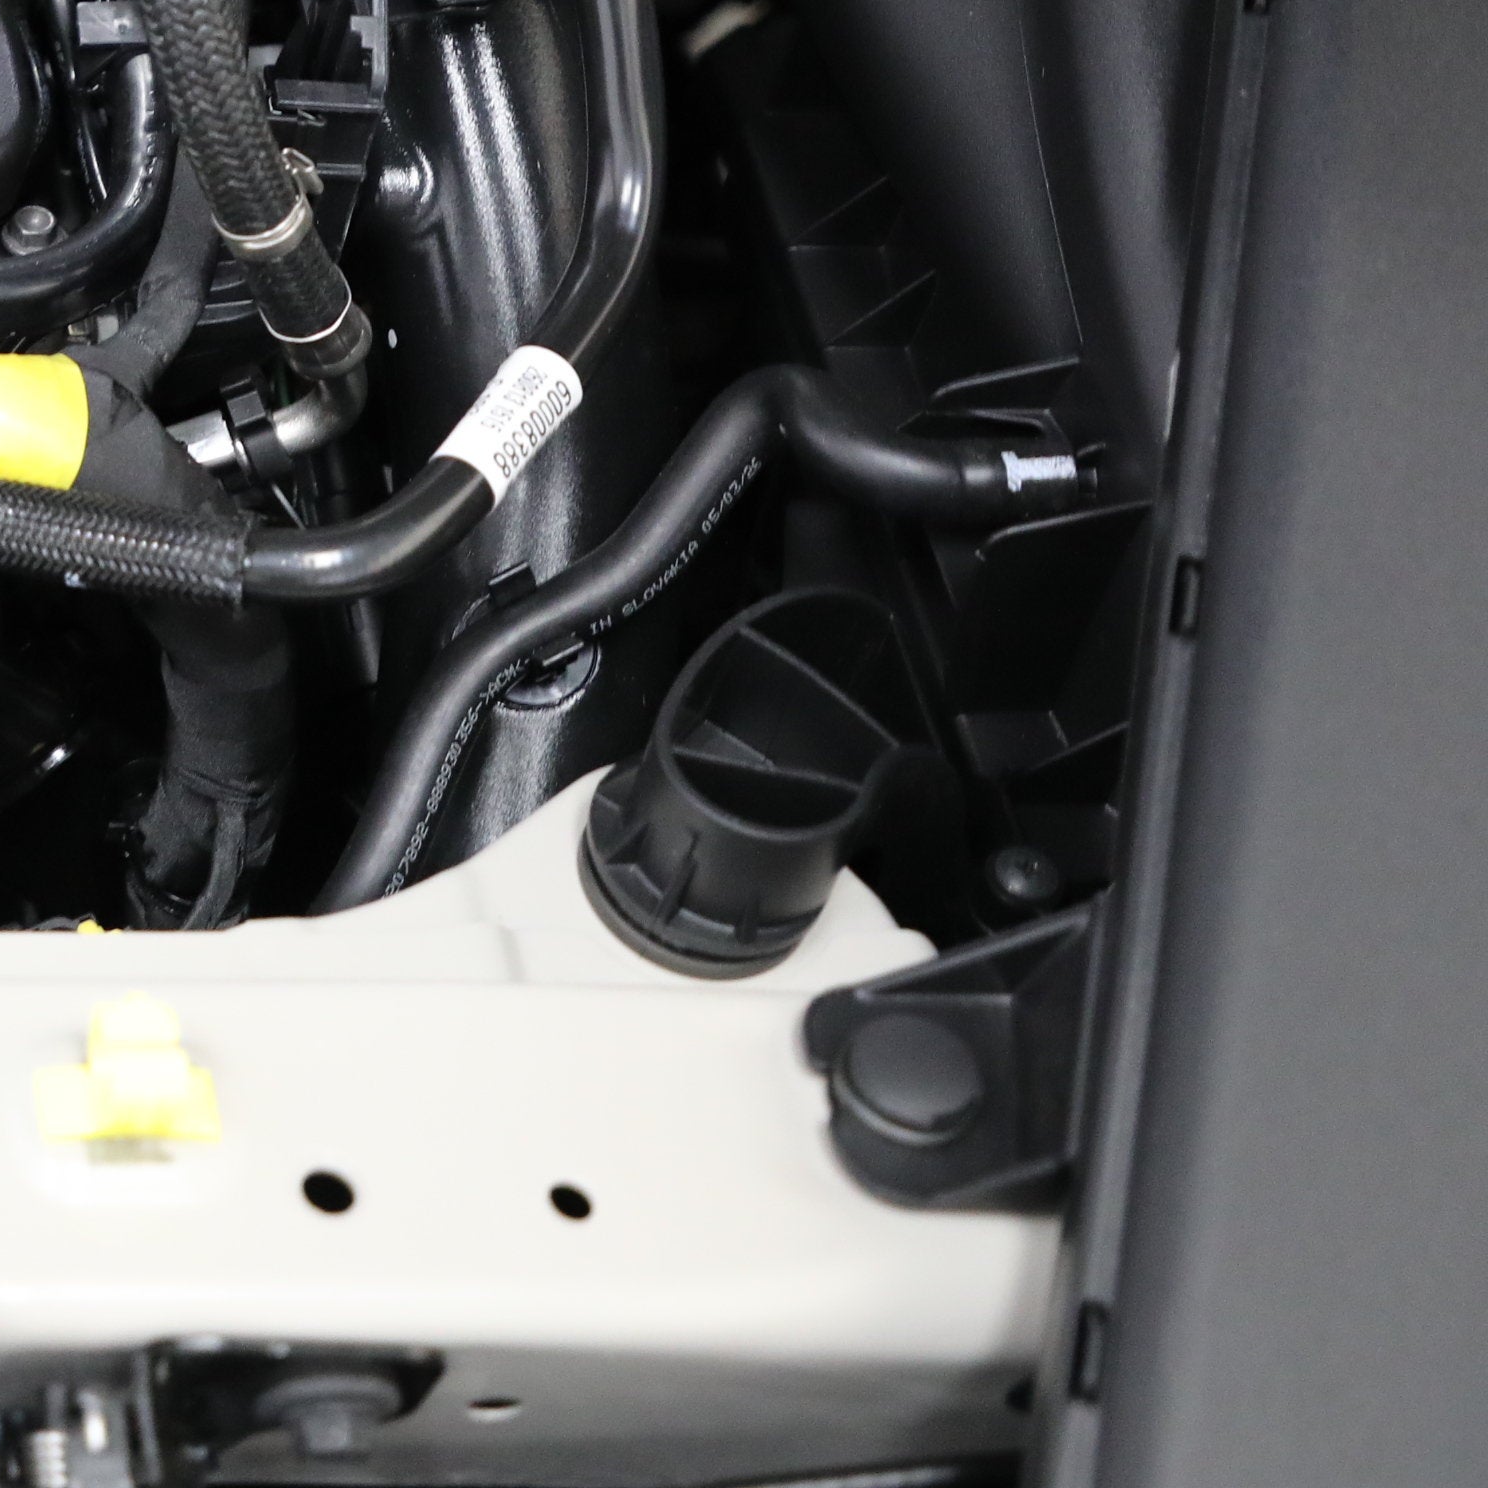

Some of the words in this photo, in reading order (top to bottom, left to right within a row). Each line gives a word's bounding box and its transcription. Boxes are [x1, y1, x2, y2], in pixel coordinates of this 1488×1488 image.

[493, 380, 571, 479] 60008388
[590, 615, 614, 635] IN
[621, 539, 700, 618] SLOVAKIA
